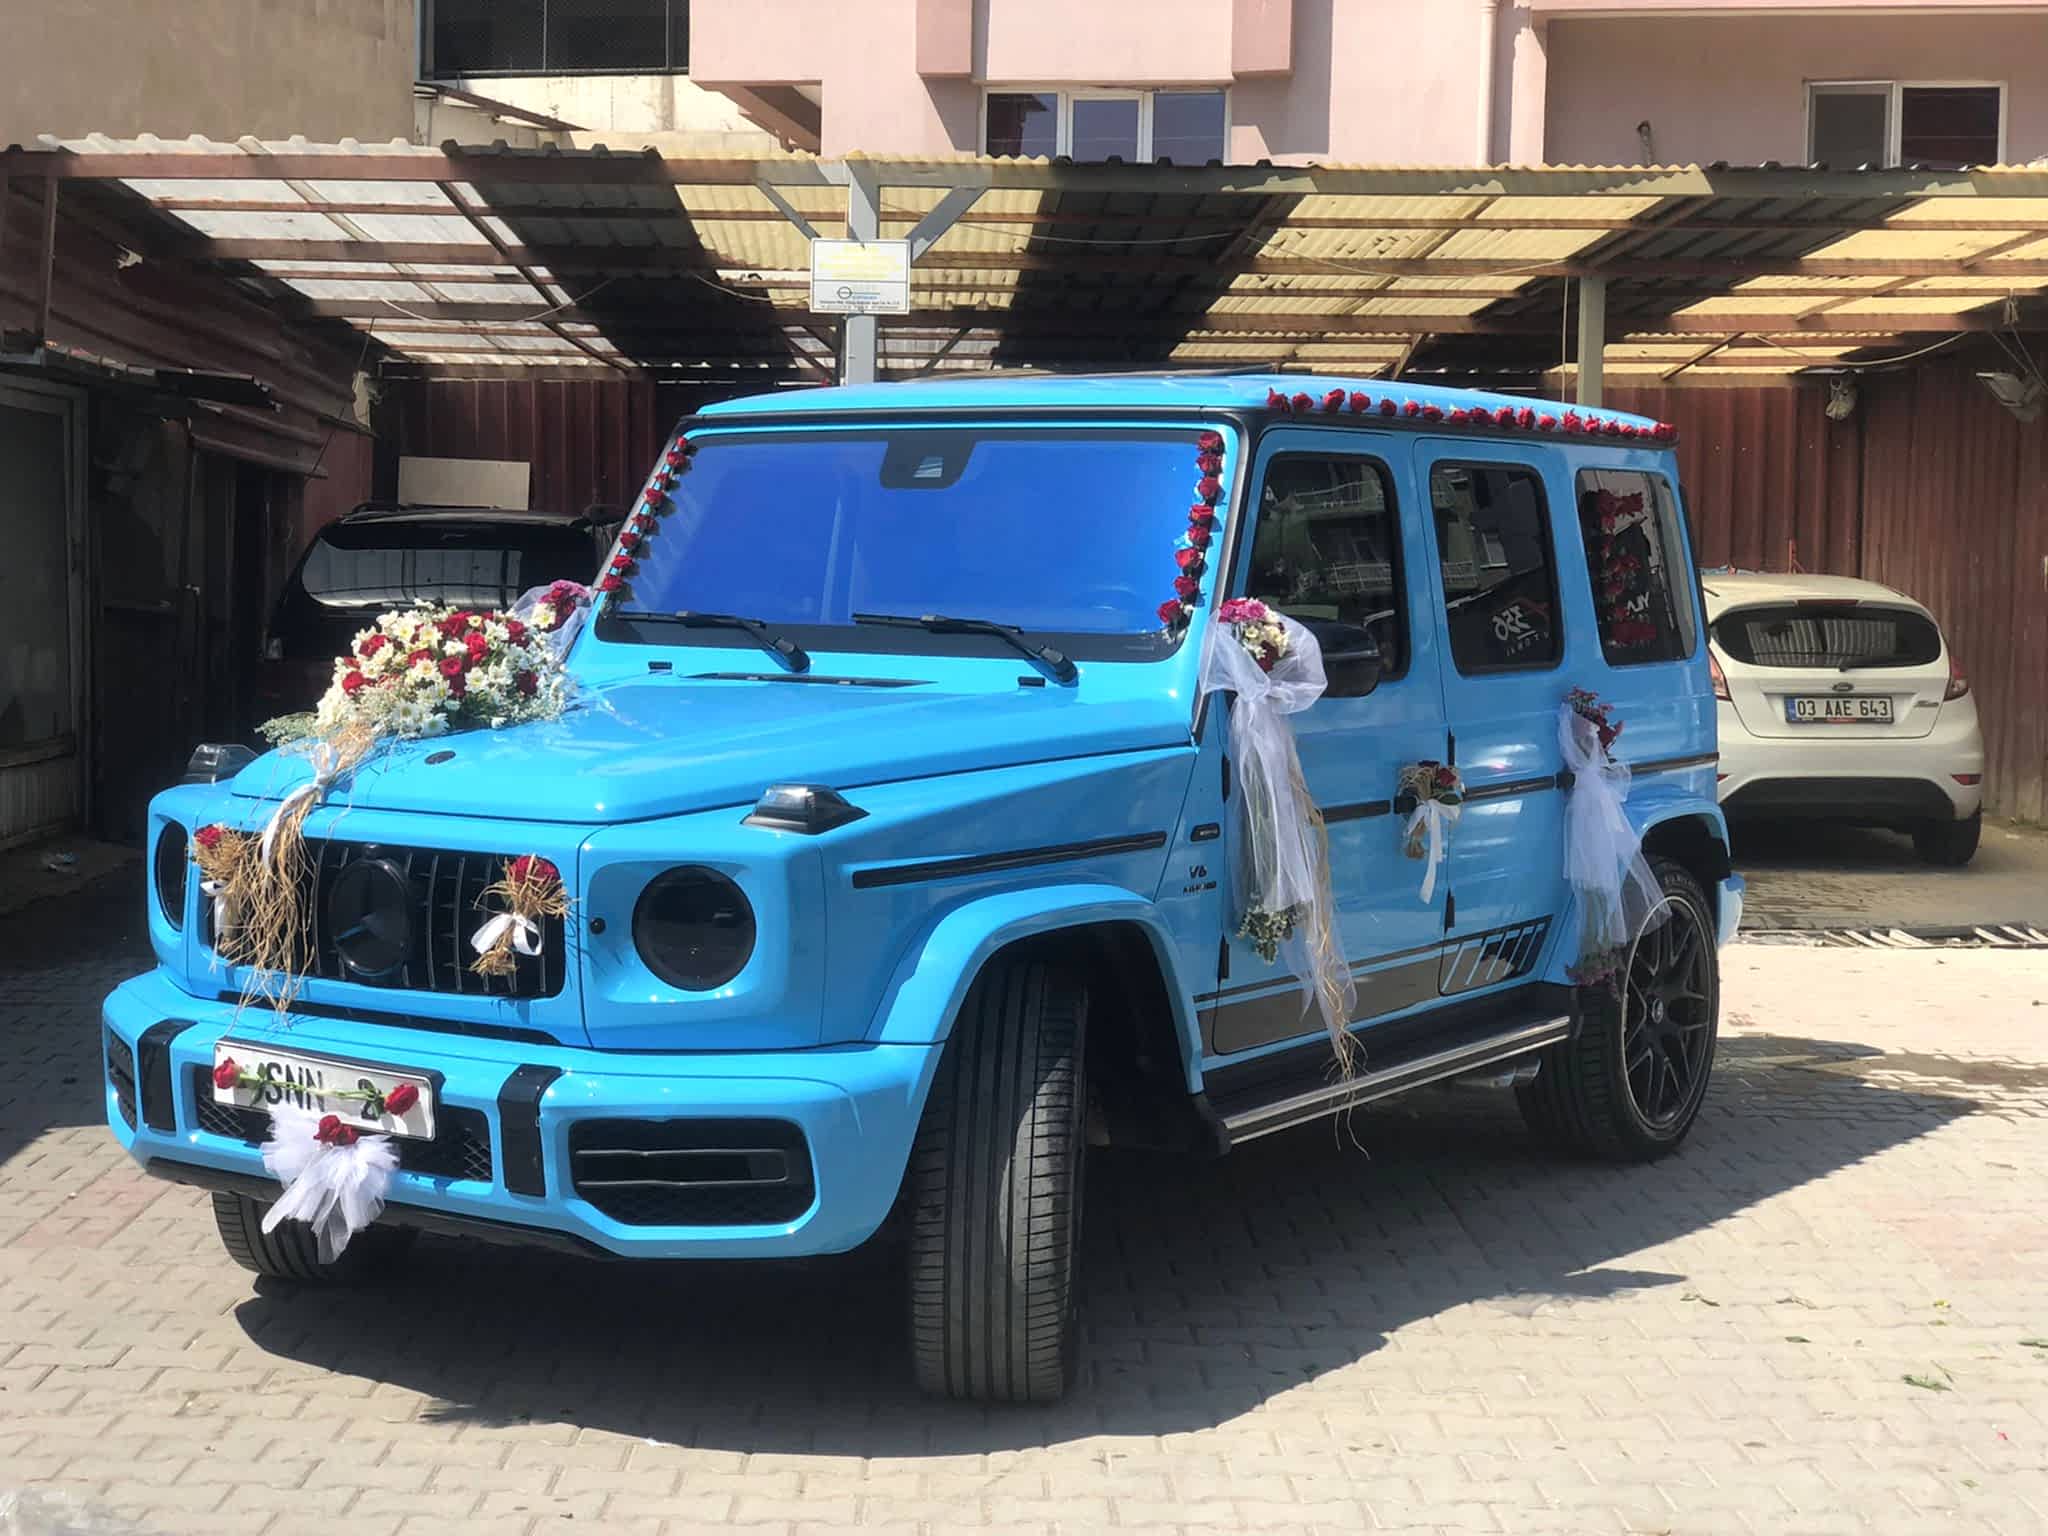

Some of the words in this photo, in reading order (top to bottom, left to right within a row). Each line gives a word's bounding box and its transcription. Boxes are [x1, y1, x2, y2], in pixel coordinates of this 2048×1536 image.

[1797, 700, 1816, 716] 03
[1825, 700, 1853, 716] AAE
[1860, 700, 1888, 717] 643
[265, 1062, 325, 1112] SNN
